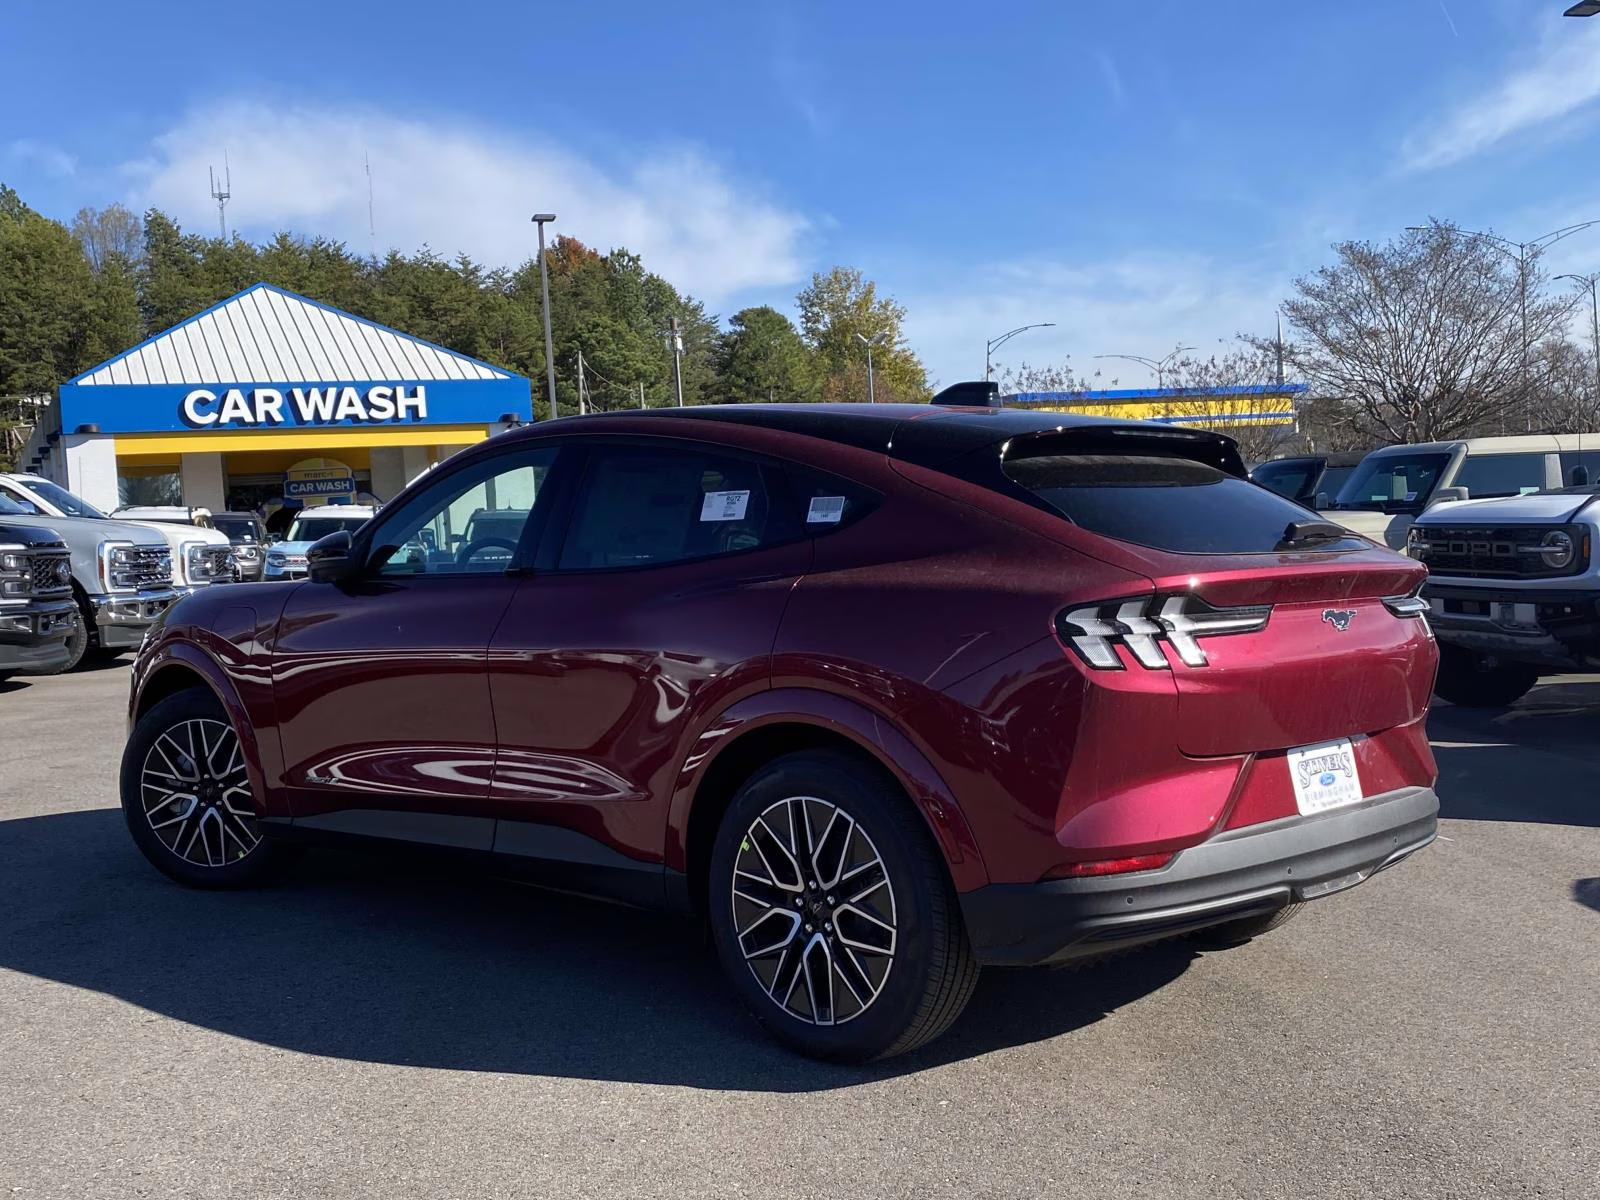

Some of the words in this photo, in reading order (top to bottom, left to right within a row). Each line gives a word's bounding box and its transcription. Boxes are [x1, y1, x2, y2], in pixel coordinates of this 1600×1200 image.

[184, 388, 284, 425] CAR
[292, 385, 427, 421] WASH
[290, 483, 314, 493] CAR
[316, 481, 350, 491] WASH
[1298, 752, 1353, 789] STIVERS
